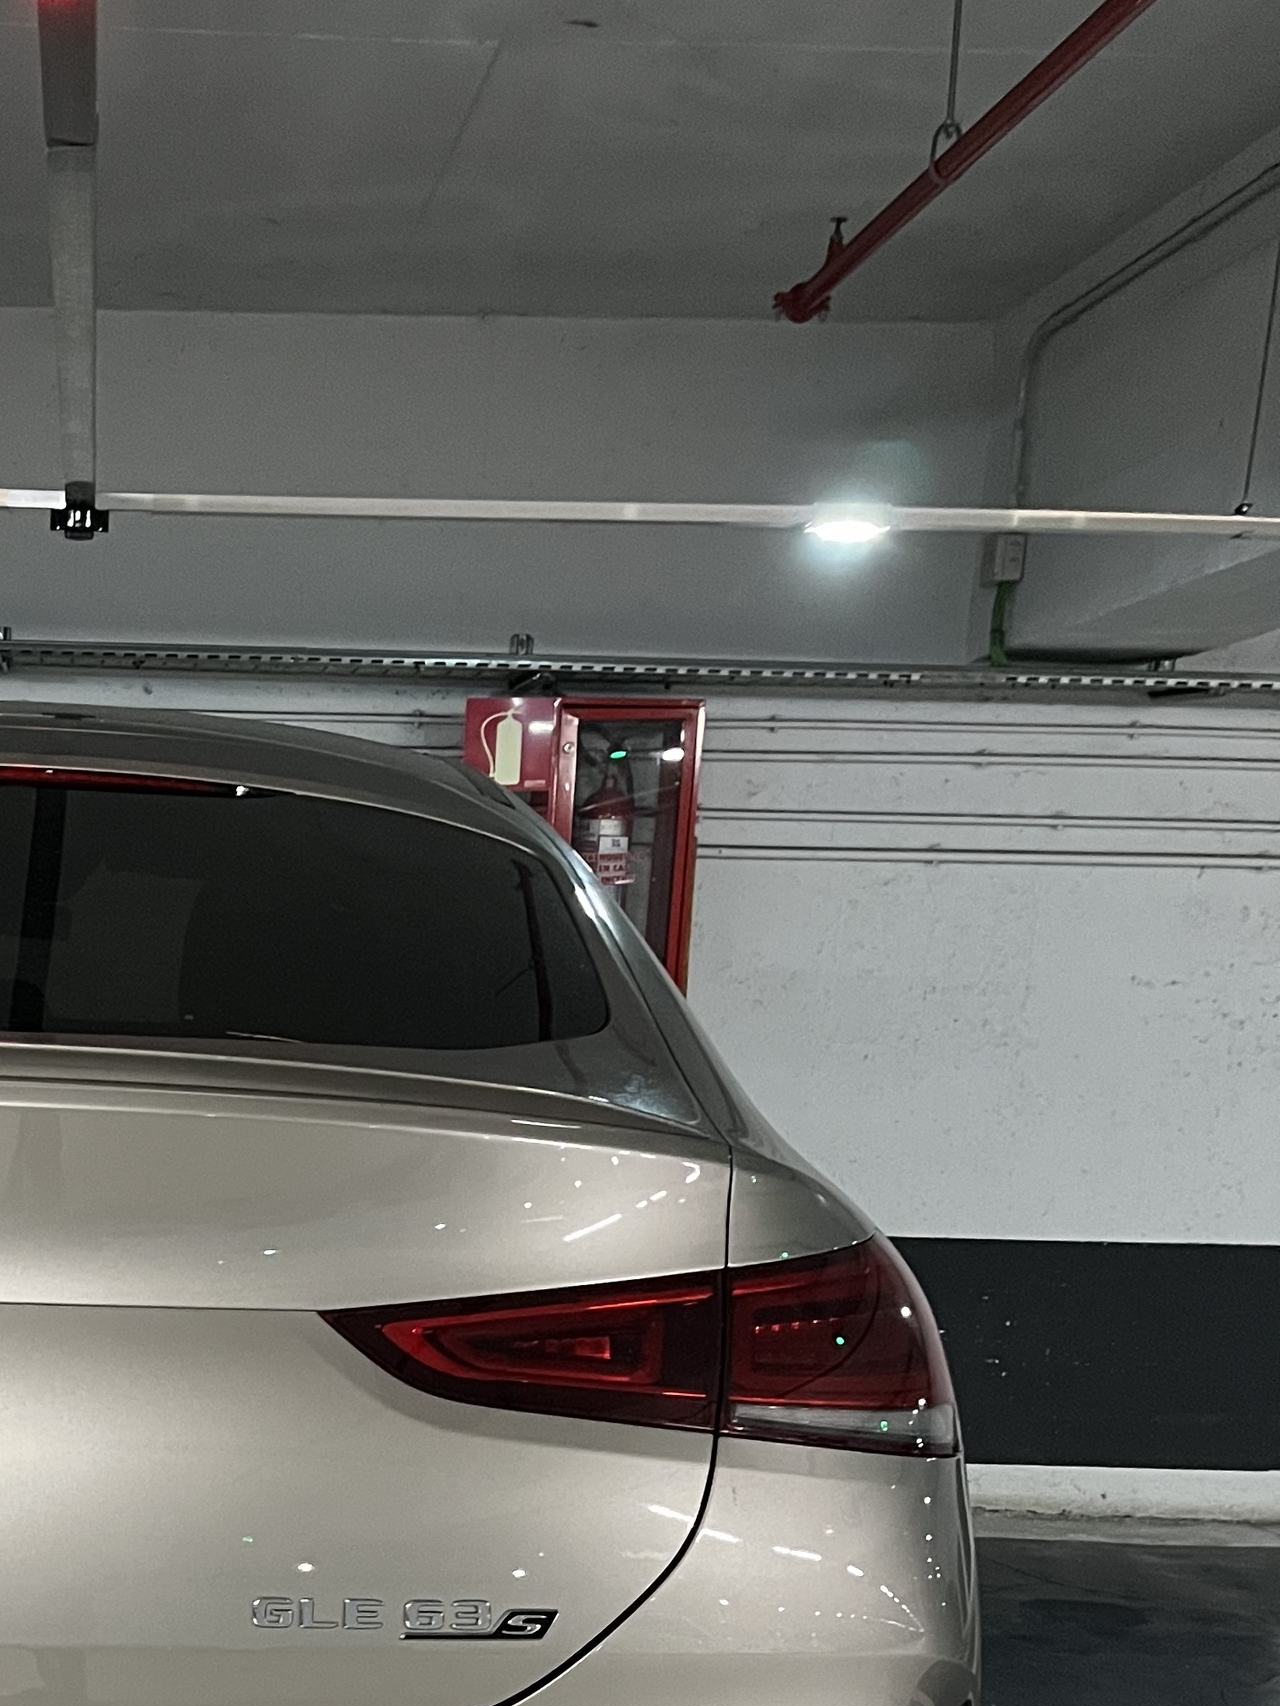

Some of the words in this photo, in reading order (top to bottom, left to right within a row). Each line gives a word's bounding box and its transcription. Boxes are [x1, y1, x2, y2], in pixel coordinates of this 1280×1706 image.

[252, 1596, 385, 1630] GLE
[403, 1599, 492, 1632] 63
[500, 1613, 548, 1636] S
